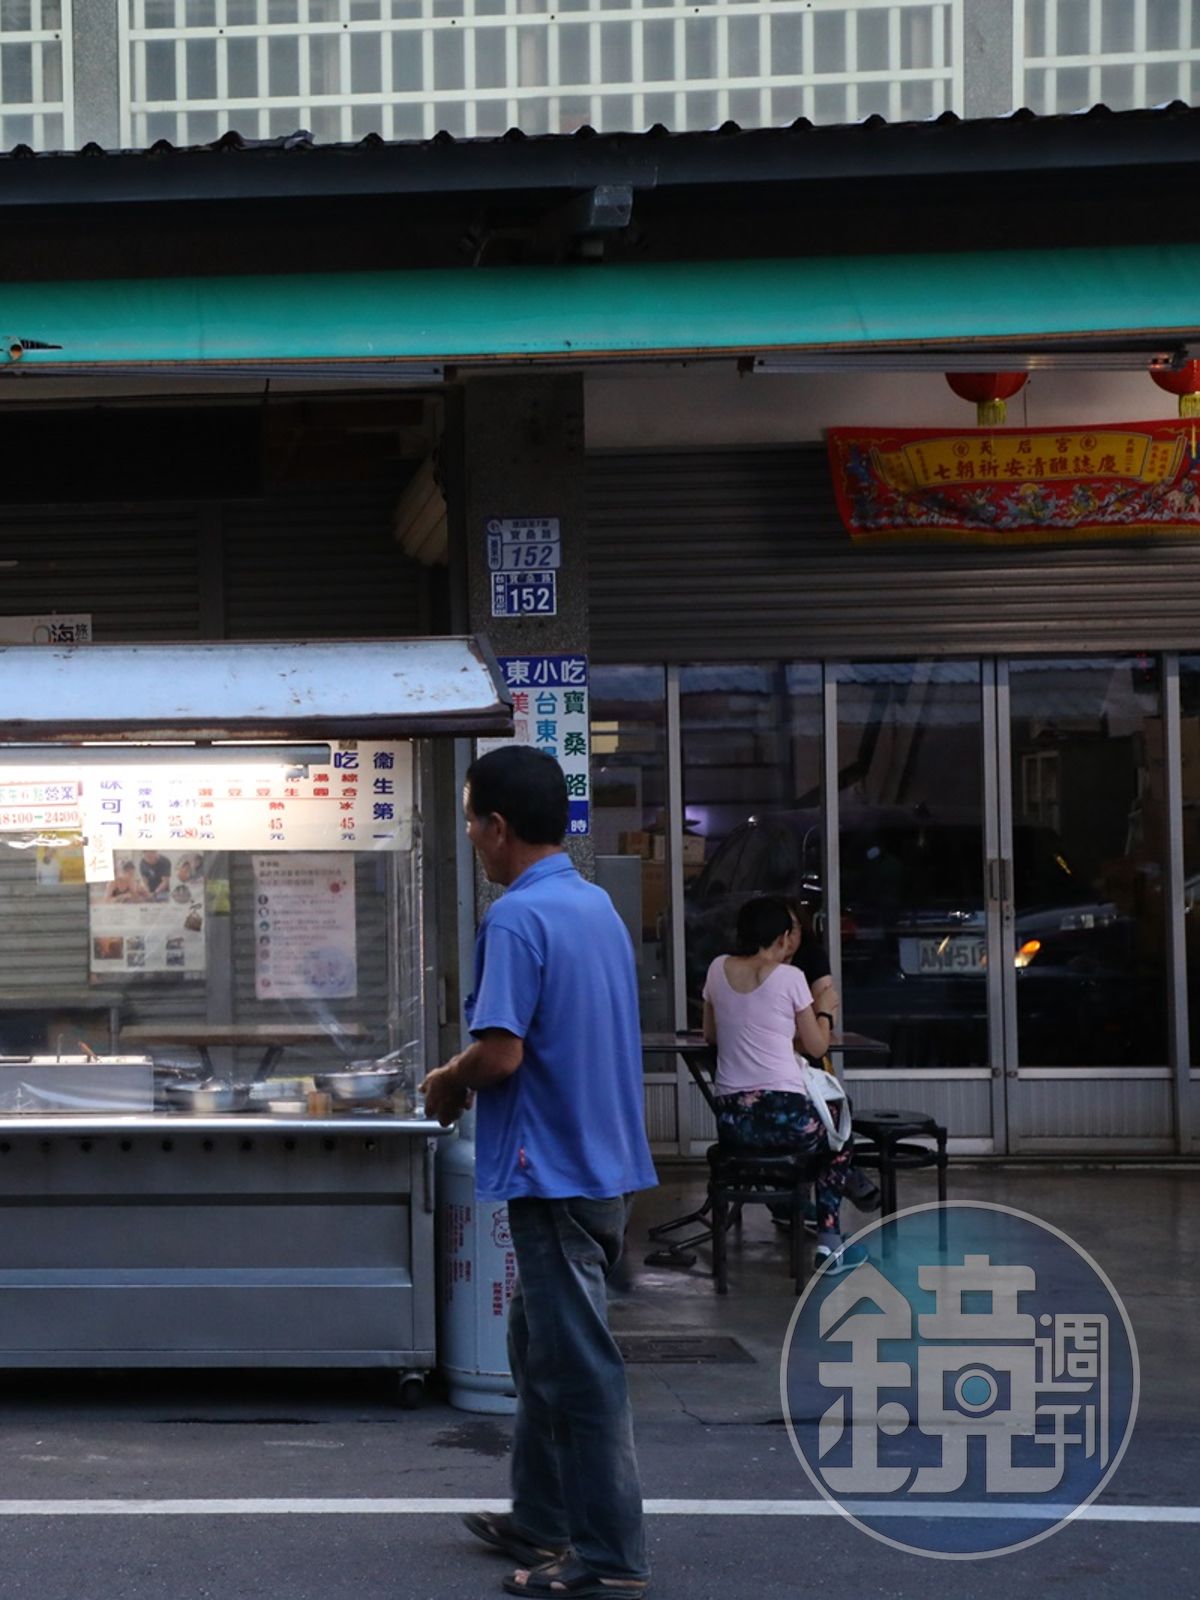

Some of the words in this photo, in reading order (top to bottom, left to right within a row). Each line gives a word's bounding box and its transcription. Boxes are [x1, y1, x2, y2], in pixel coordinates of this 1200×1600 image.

[511, 545, 553, 567] 152
[510, 588, 550, 611] 152
[499, 659, 586, 684] 東小吃
[564, 690, 587, 797] 寶桑路
[268, 818, 283, 830] 45
[340, 818, 355, 830] 45
